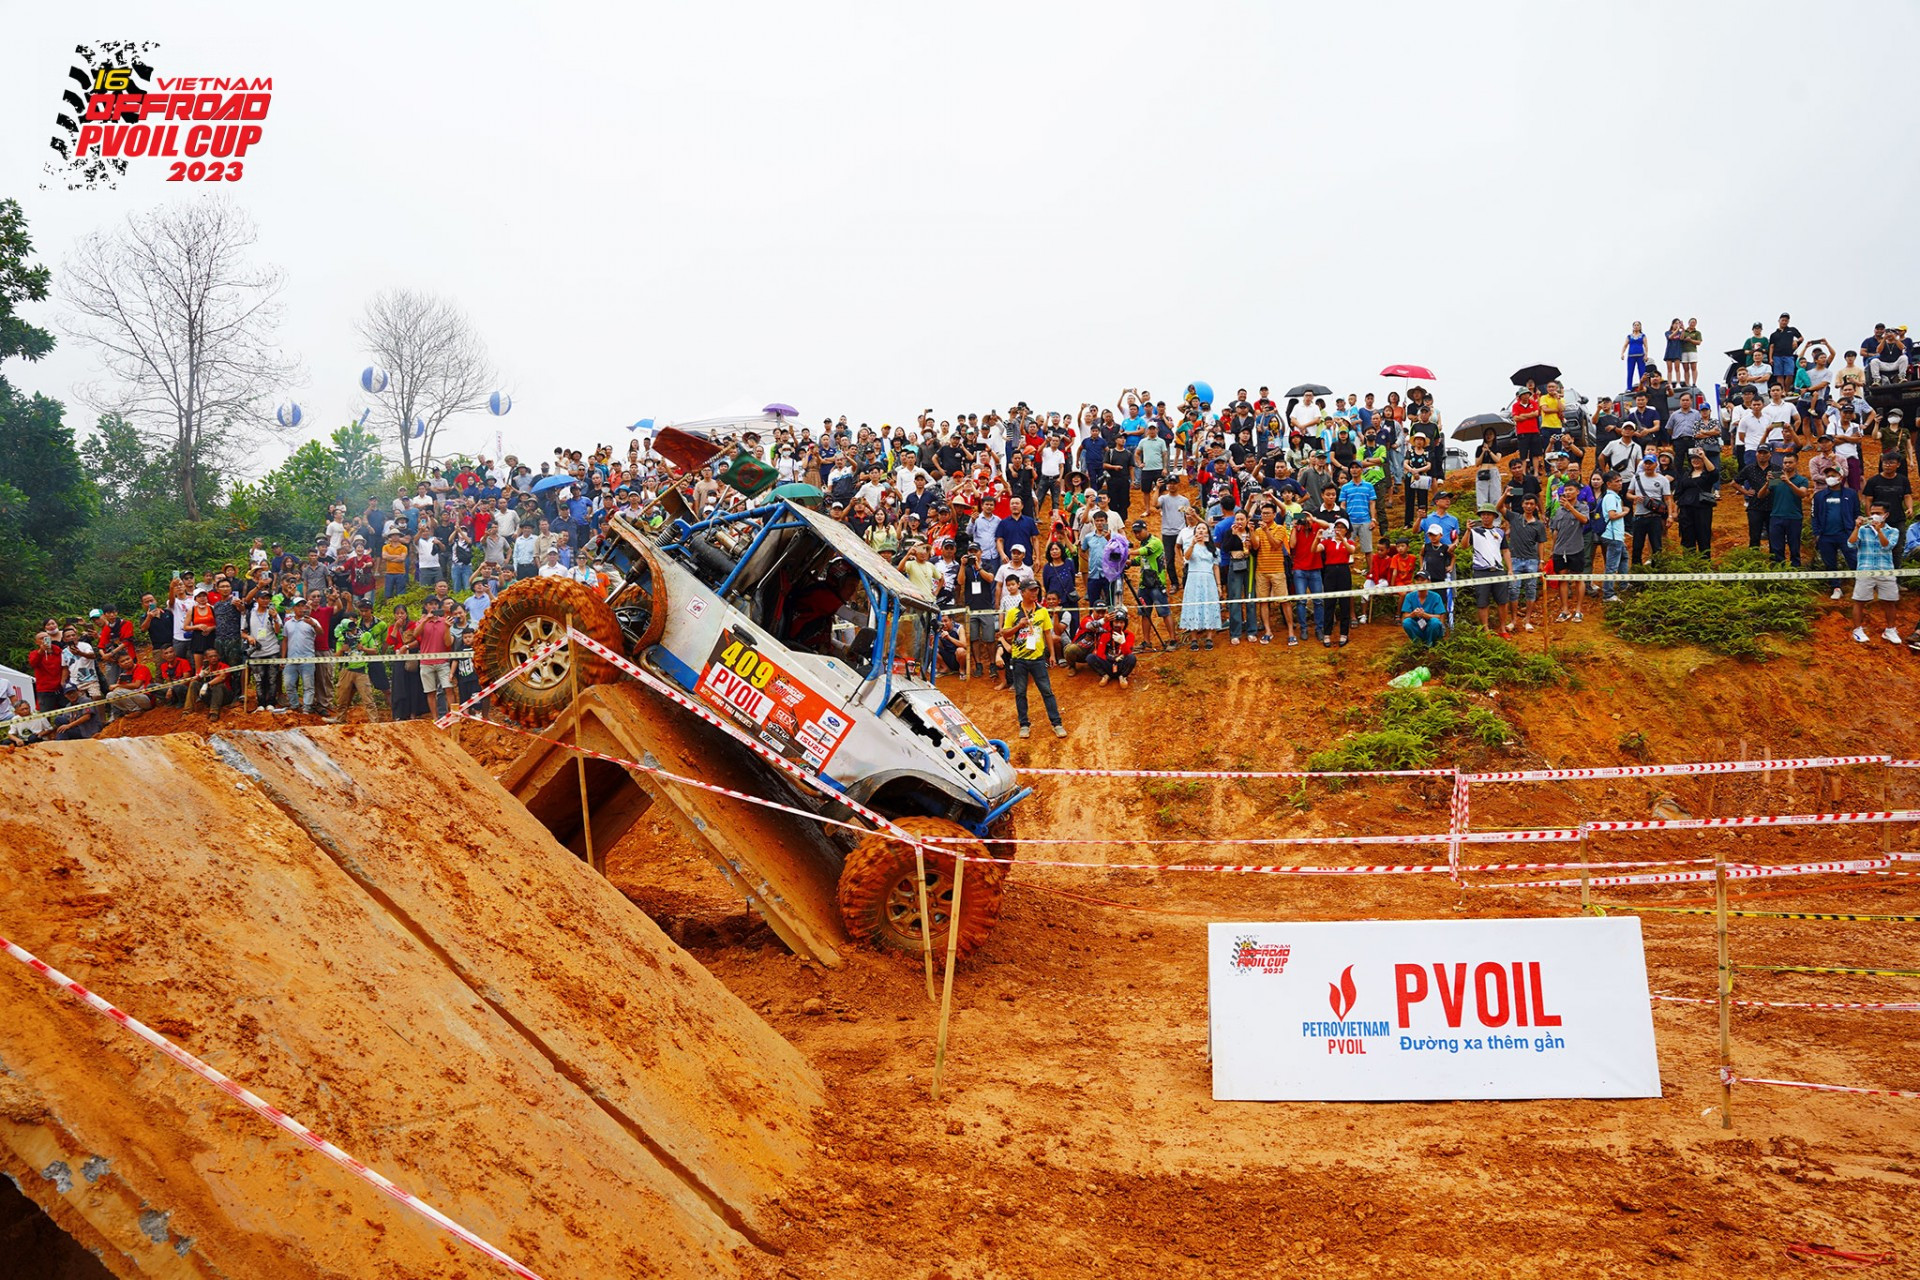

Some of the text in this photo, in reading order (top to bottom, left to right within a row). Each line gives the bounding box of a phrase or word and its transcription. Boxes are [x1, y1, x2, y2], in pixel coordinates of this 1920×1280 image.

[721, 641, 775, 689] 409
[711, 668, 763, 719] PVOIL
[799, 735, 825, 755] ISUZU
[1237, 958, 1288, 967] PVOIL CUP
[1395, 962, 1562, 1028] PVOIL
[1302, 1021, 1390, 1038] PETROVIETNAM
[1329, 1039, 1367, 1054] PVOIL
[1399, 1032, 1566, 1055] Đường xa thêm gần
